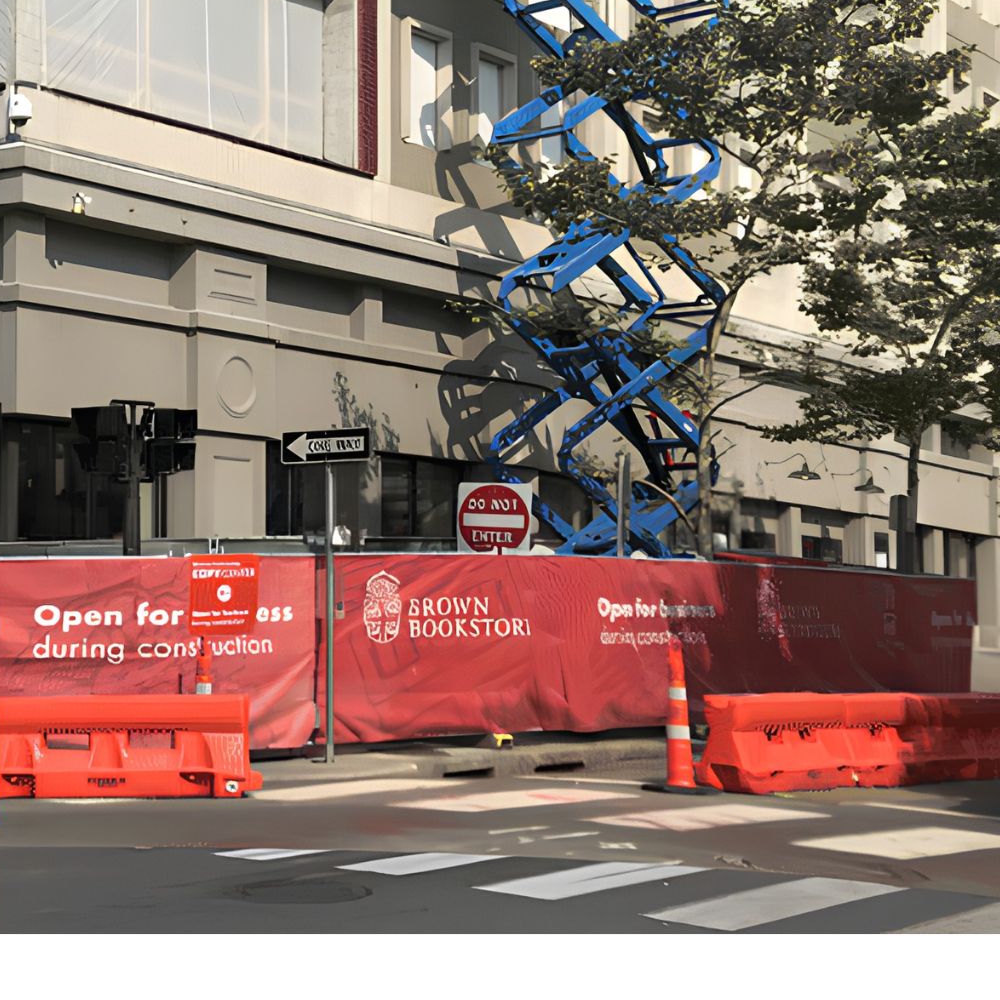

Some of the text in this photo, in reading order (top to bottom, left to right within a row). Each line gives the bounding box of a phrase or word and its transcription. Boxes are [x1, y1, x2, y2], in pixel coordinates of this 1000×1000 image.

[468, 498, 518, 511] DO NOT
[472, 530, 513, 543] ENTER
[33, 601, 185, 633] Open for
[408, 596, 489, 617] BROWN
[32, 634, 125, 664] during
